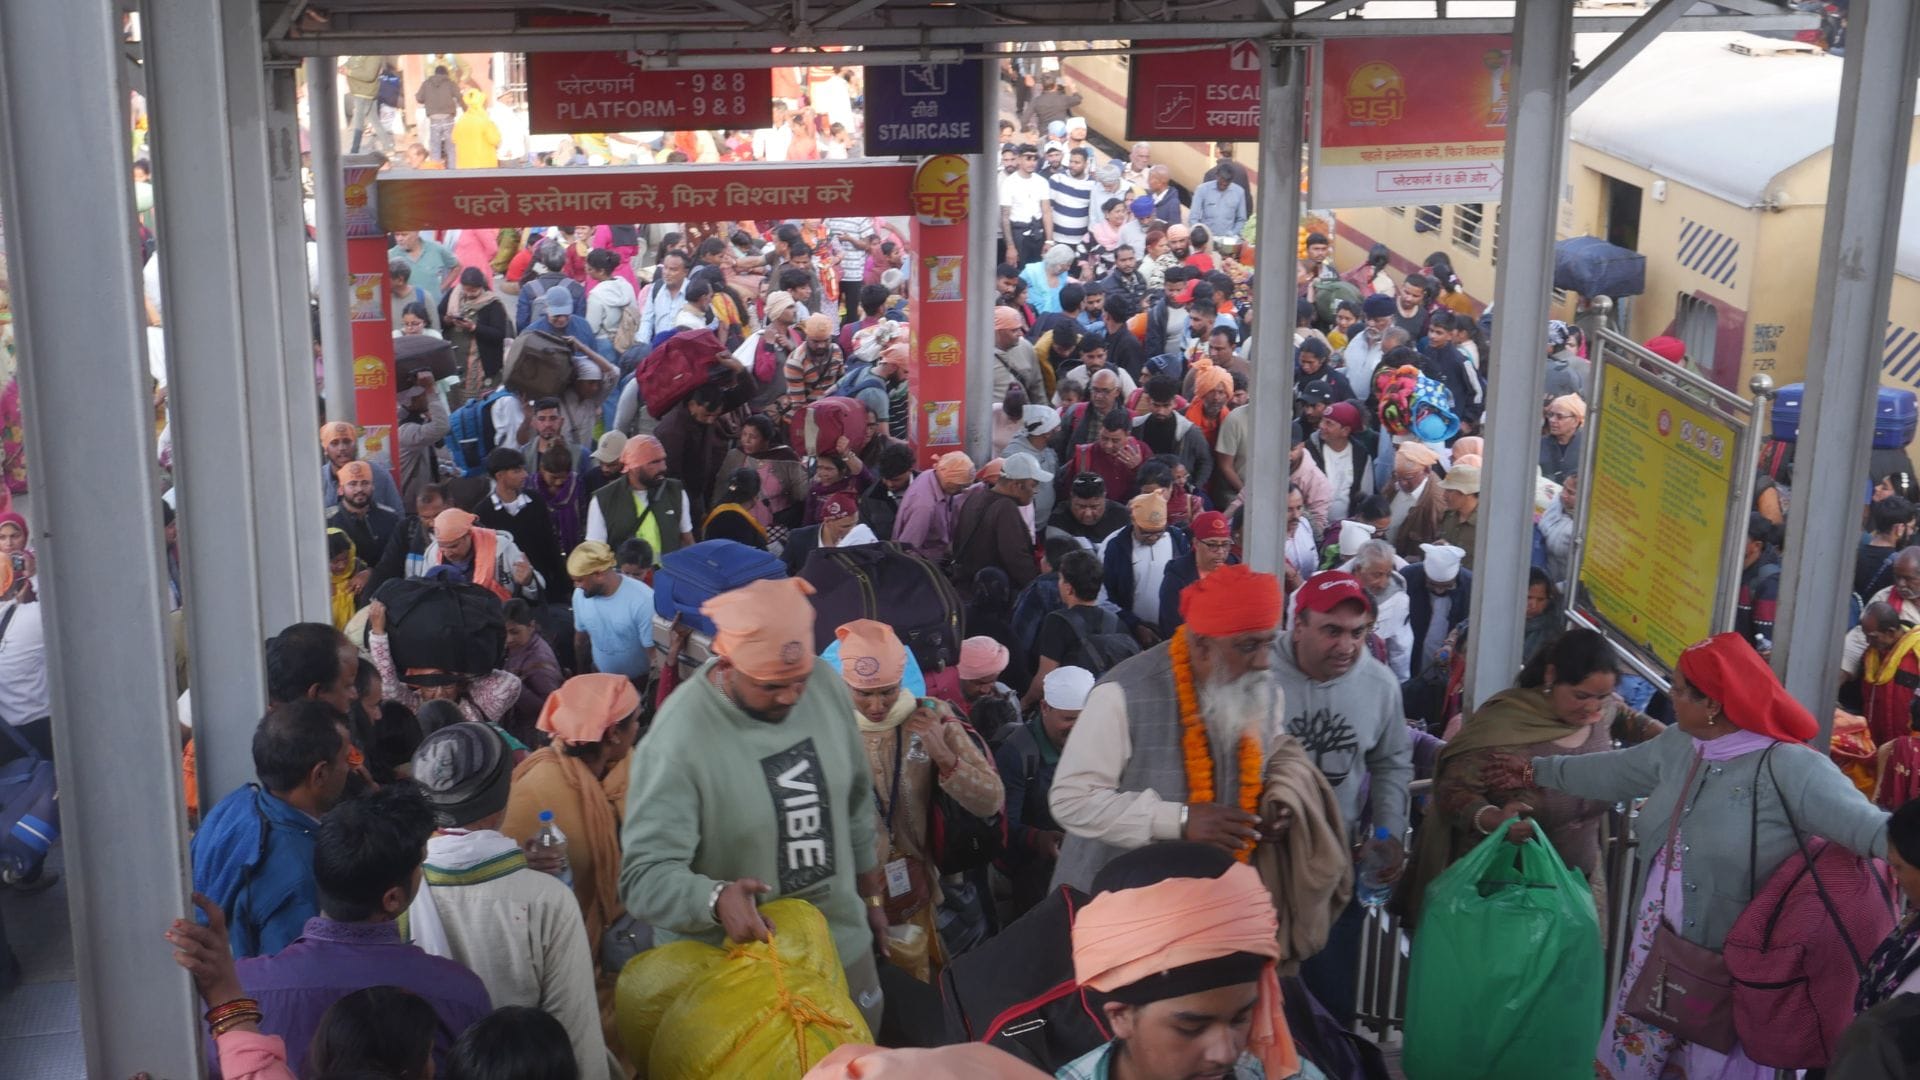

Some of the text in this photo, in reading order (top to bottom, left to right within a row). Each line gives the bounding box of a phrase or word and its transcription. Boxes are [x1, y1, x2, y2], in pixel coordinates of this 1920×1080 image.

[692, 74, 706, 93] 9
[712, 74, 727, 91] &
[732, 72, 745, 92] 8
[1206, 84, 1261, 100] ESCAL
[693, 97, 706, 116] 9
[712, 98, 728, 115] &
[733, 96, 746, 115] 8
[879, 122, 971, 140] STAIRCASE
[1454, 171, 1468, 184] की
[453, 178, 854, 216] पहले इस्तेमाल करें, फिर विश्वास करें
[776, 759, 827, 870] VIBE
